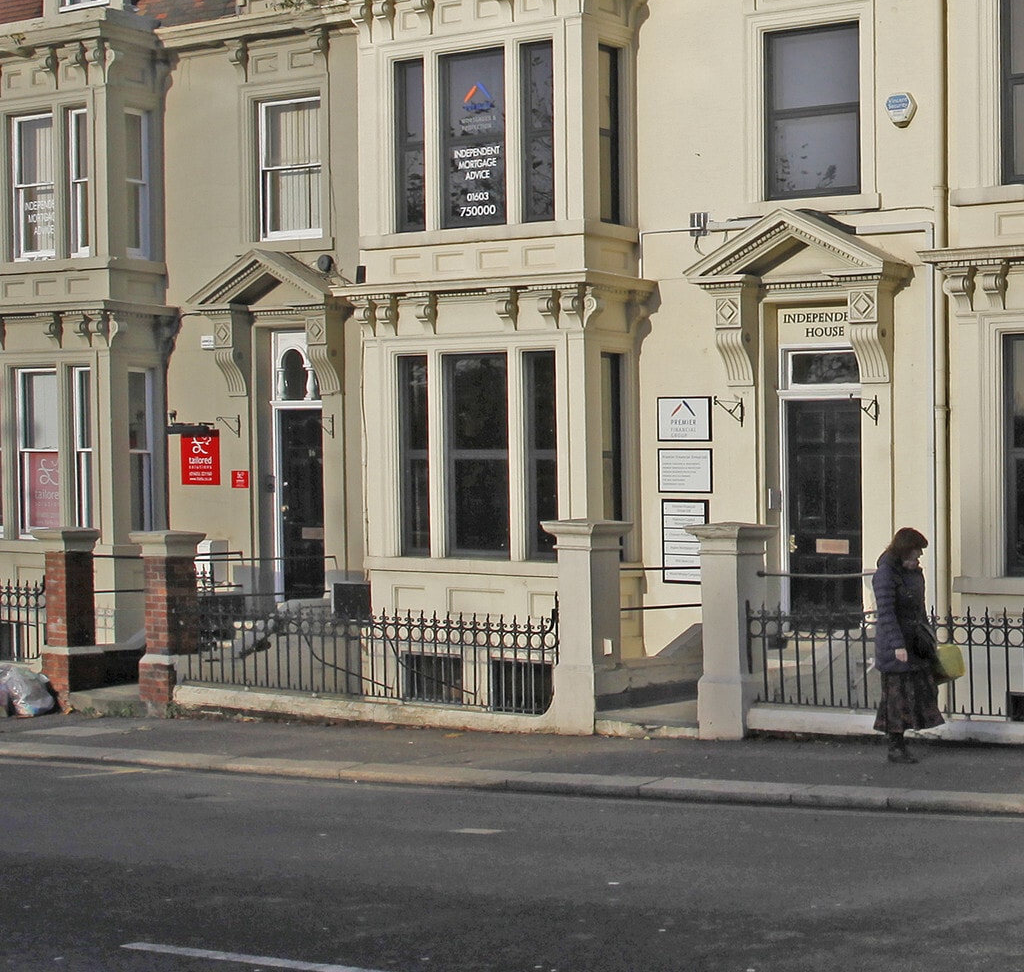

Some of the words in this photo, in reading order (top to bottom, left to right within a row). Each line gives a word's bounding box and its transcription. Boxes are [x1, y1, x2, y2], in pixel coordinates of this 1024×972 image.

[454, 146, 500, 158] INDEPENDENT
[458, 158, 497, 169] MORTGAGE
[465, 170, 490, 180] ADVICE
[466, 192, 489, 201] 01603
[460, 205, 496, 216] 750000
[805, 326, 845, 338] HOUSE
[188, 456, 213, 465] tailored
